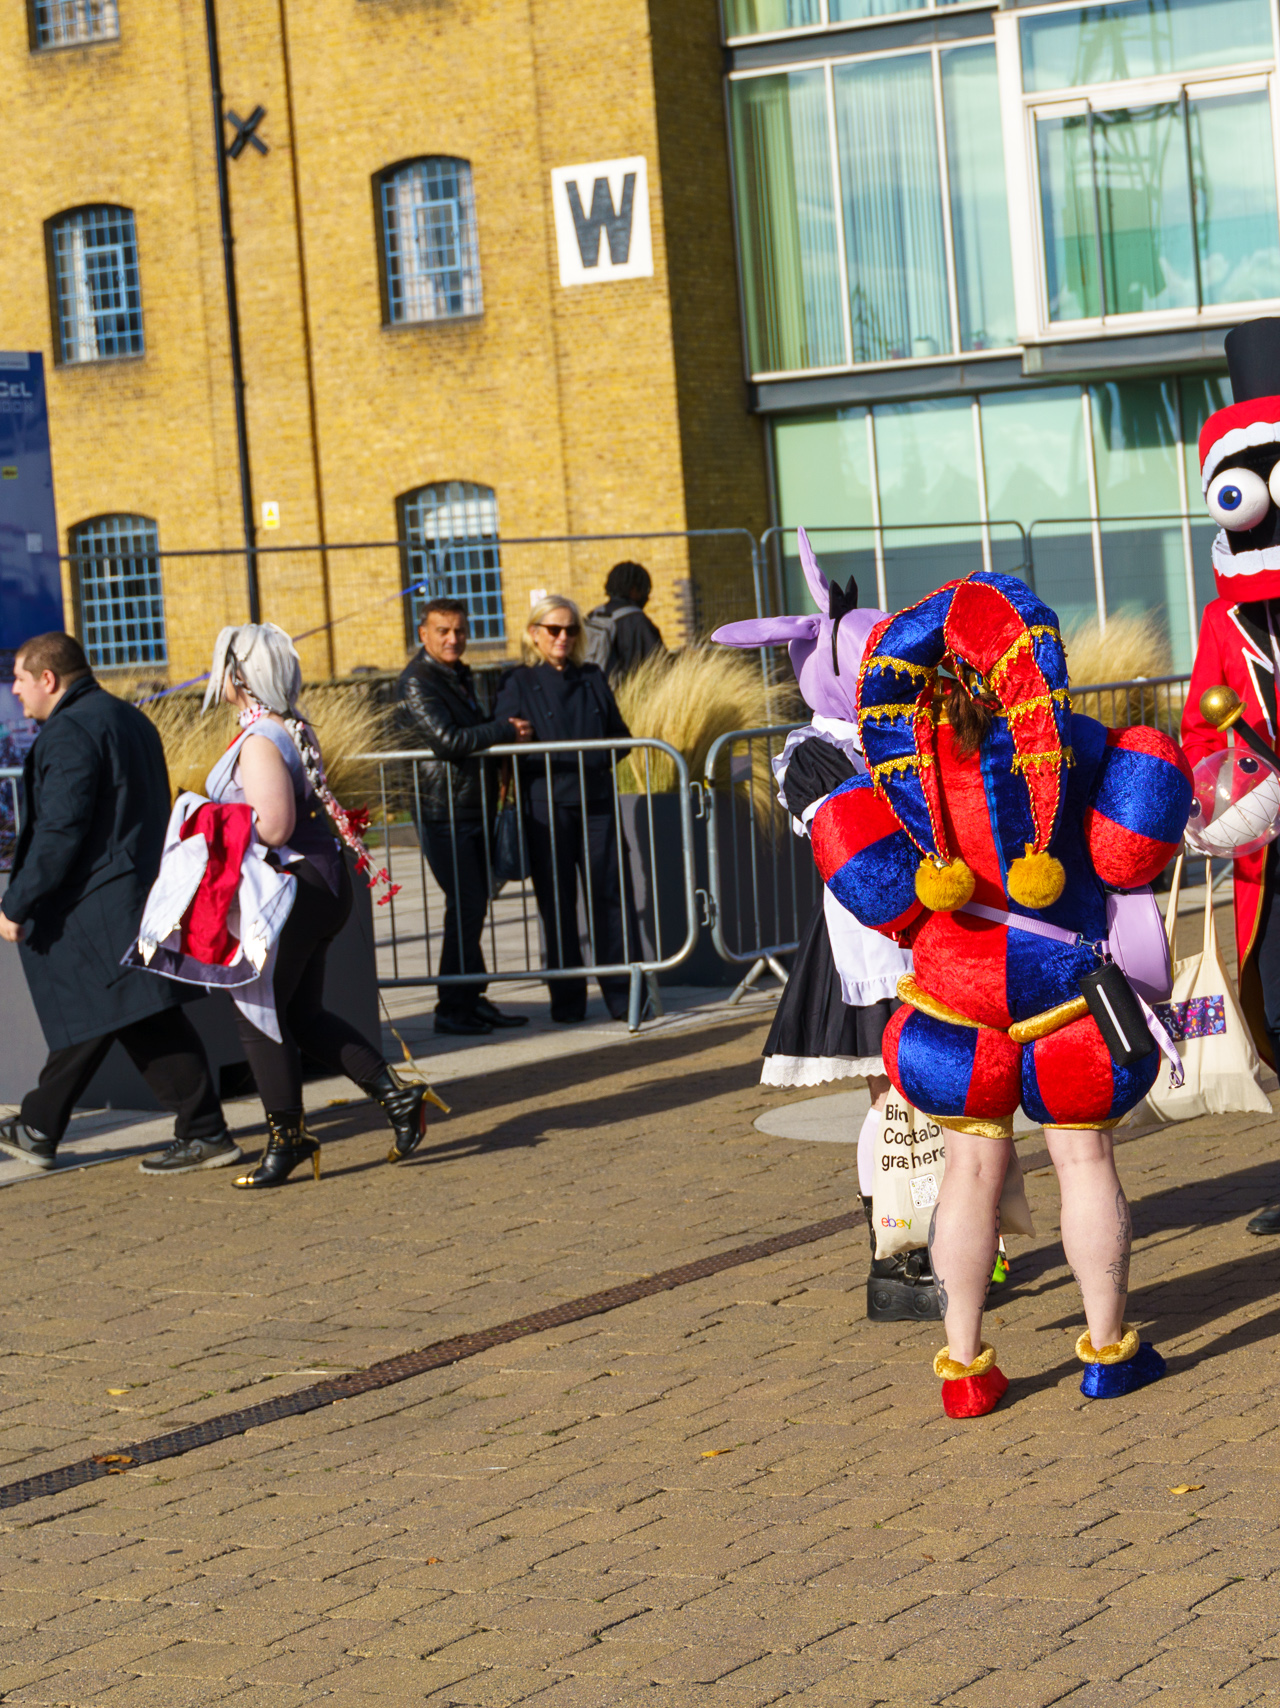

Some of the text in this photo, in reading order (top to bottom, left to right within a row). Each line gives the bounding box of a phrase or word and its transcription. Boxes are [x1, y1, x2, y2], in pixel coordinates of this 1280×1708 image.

[564, 171, 637, 269] W
[885, 1103, 909, 1123] Bin
[881, 1214, 912, 1230] ebay
